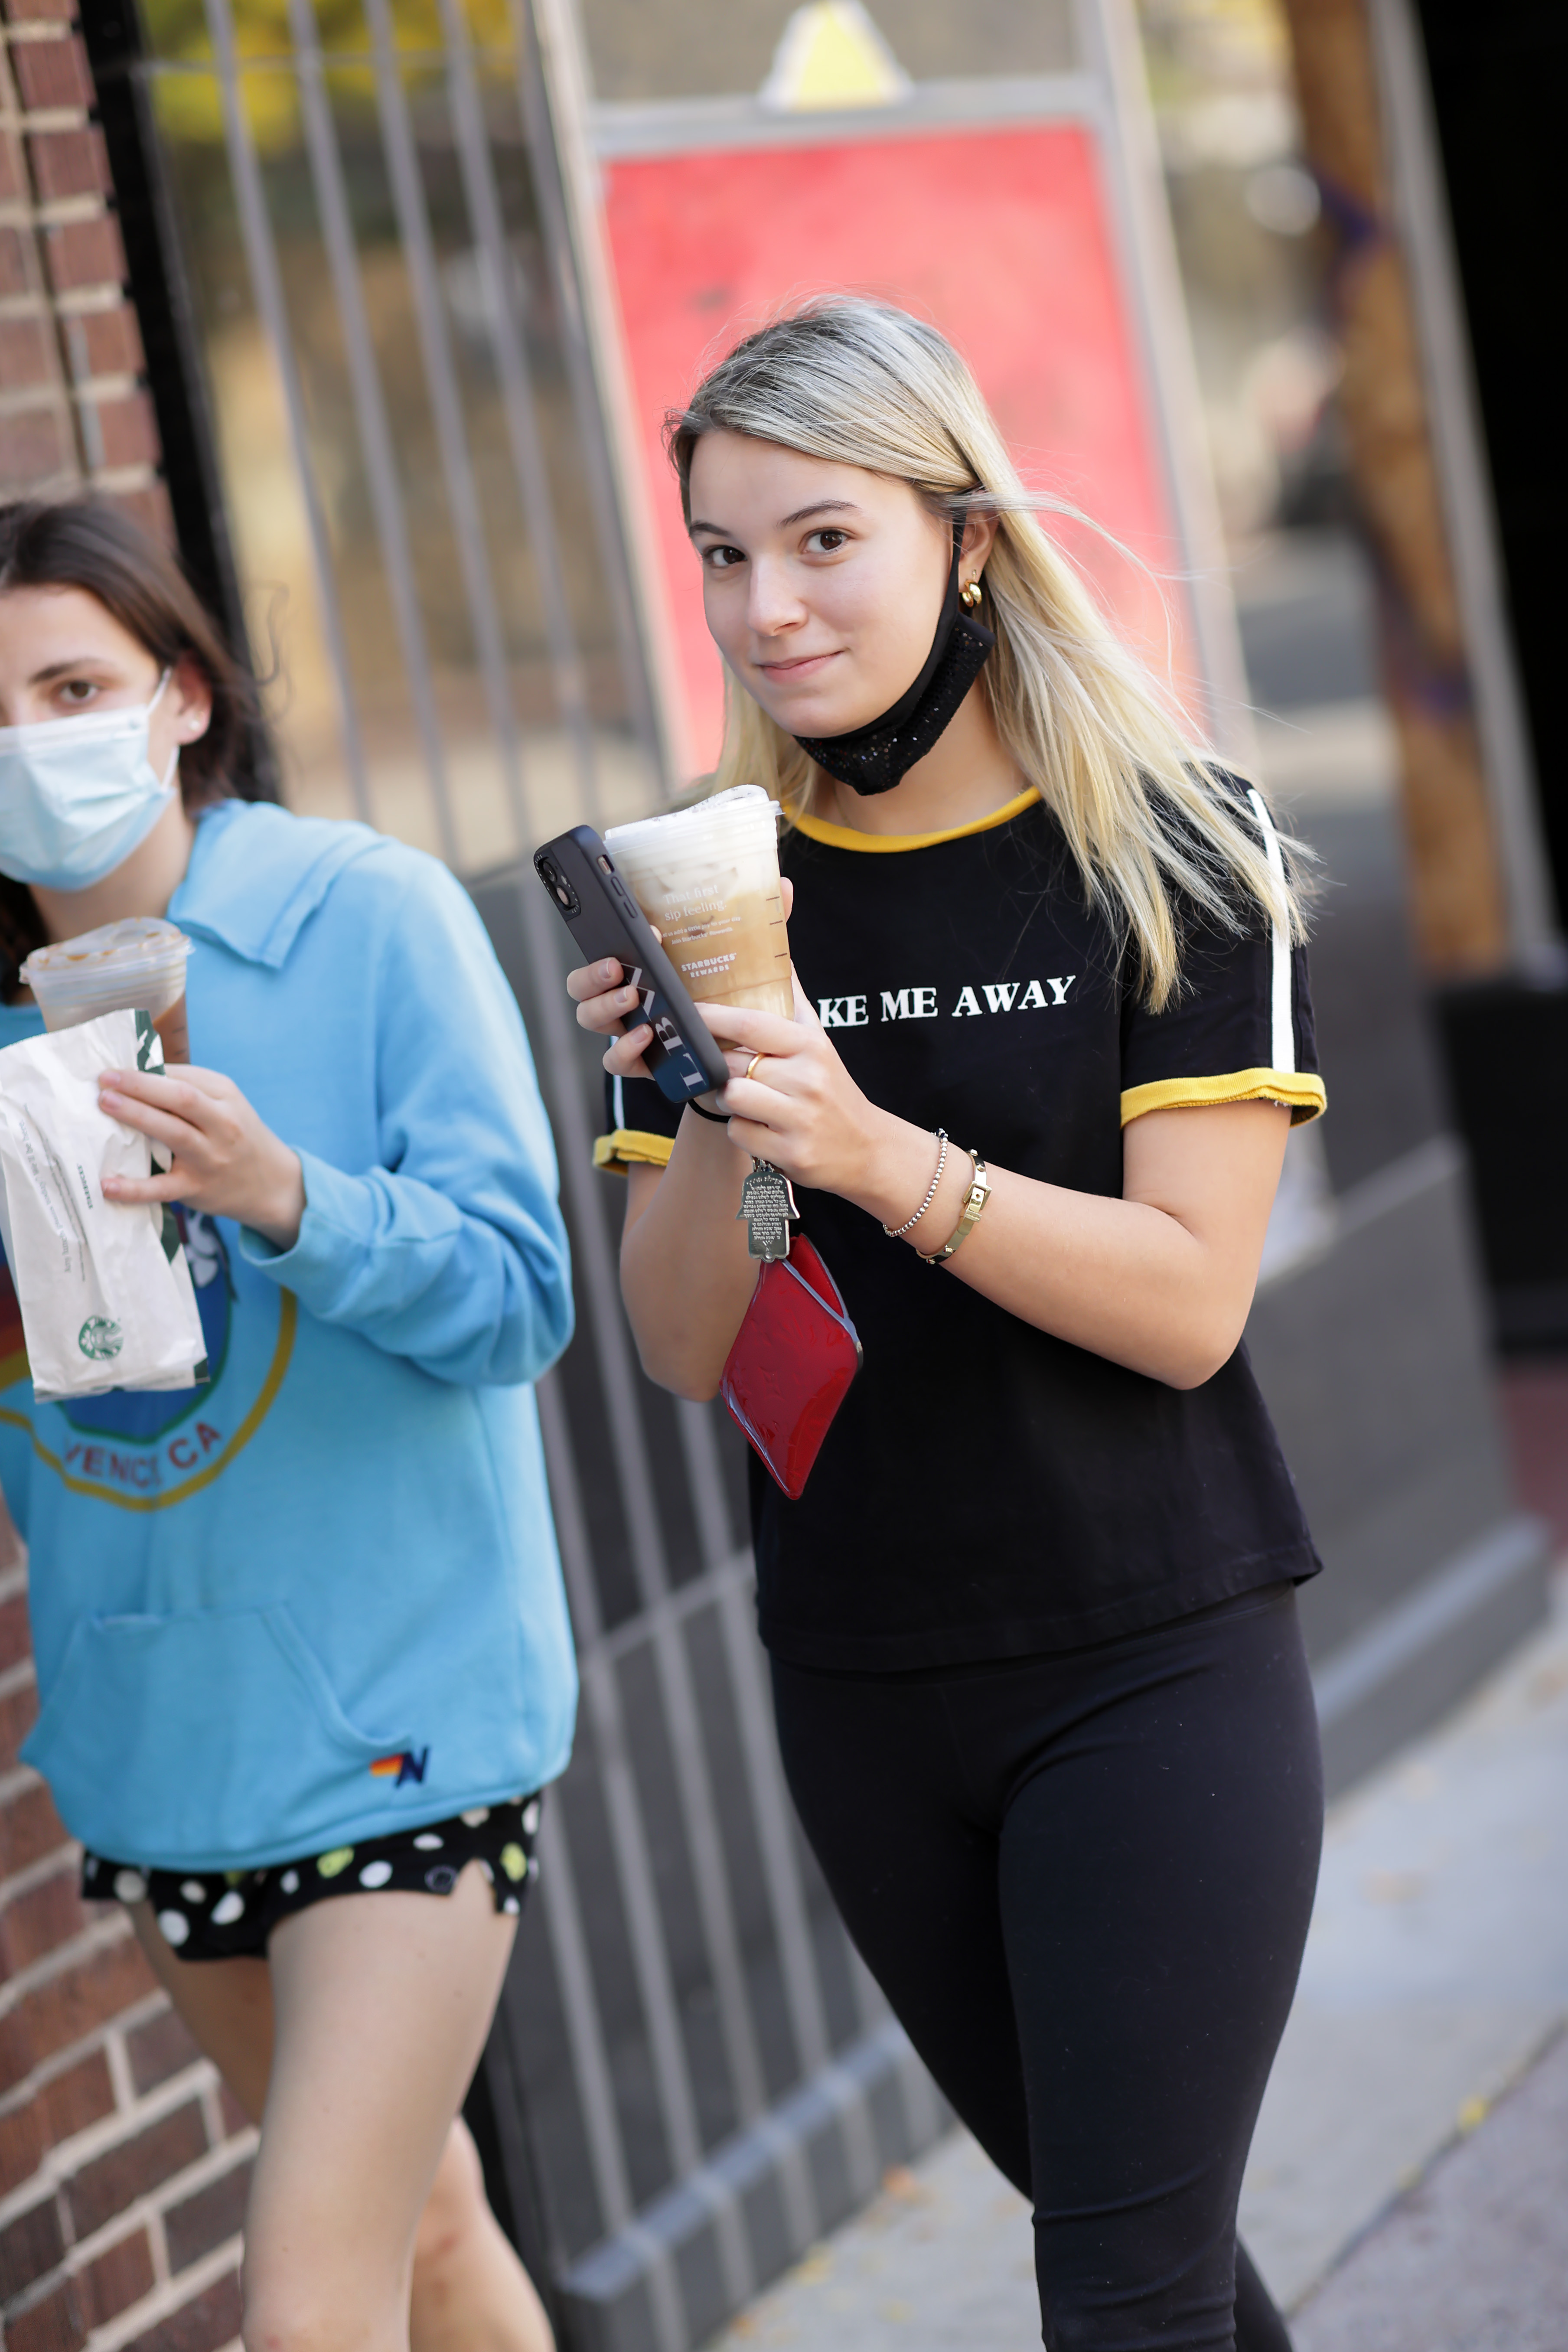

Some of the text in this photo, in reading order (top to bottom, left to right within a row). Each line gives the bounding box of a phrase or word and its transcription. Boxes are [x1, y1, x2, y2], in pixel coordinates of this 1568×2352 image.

[663, 884, 718, 904] That first
[665, 900, 727, 922] sip feeling.
[690, 963, 730, 978] REWARDS
[880, 987, 939, 1022] ME
[952, 975, 1076, 1018] AWAY
[168, 1422, 221, 1469] CA
